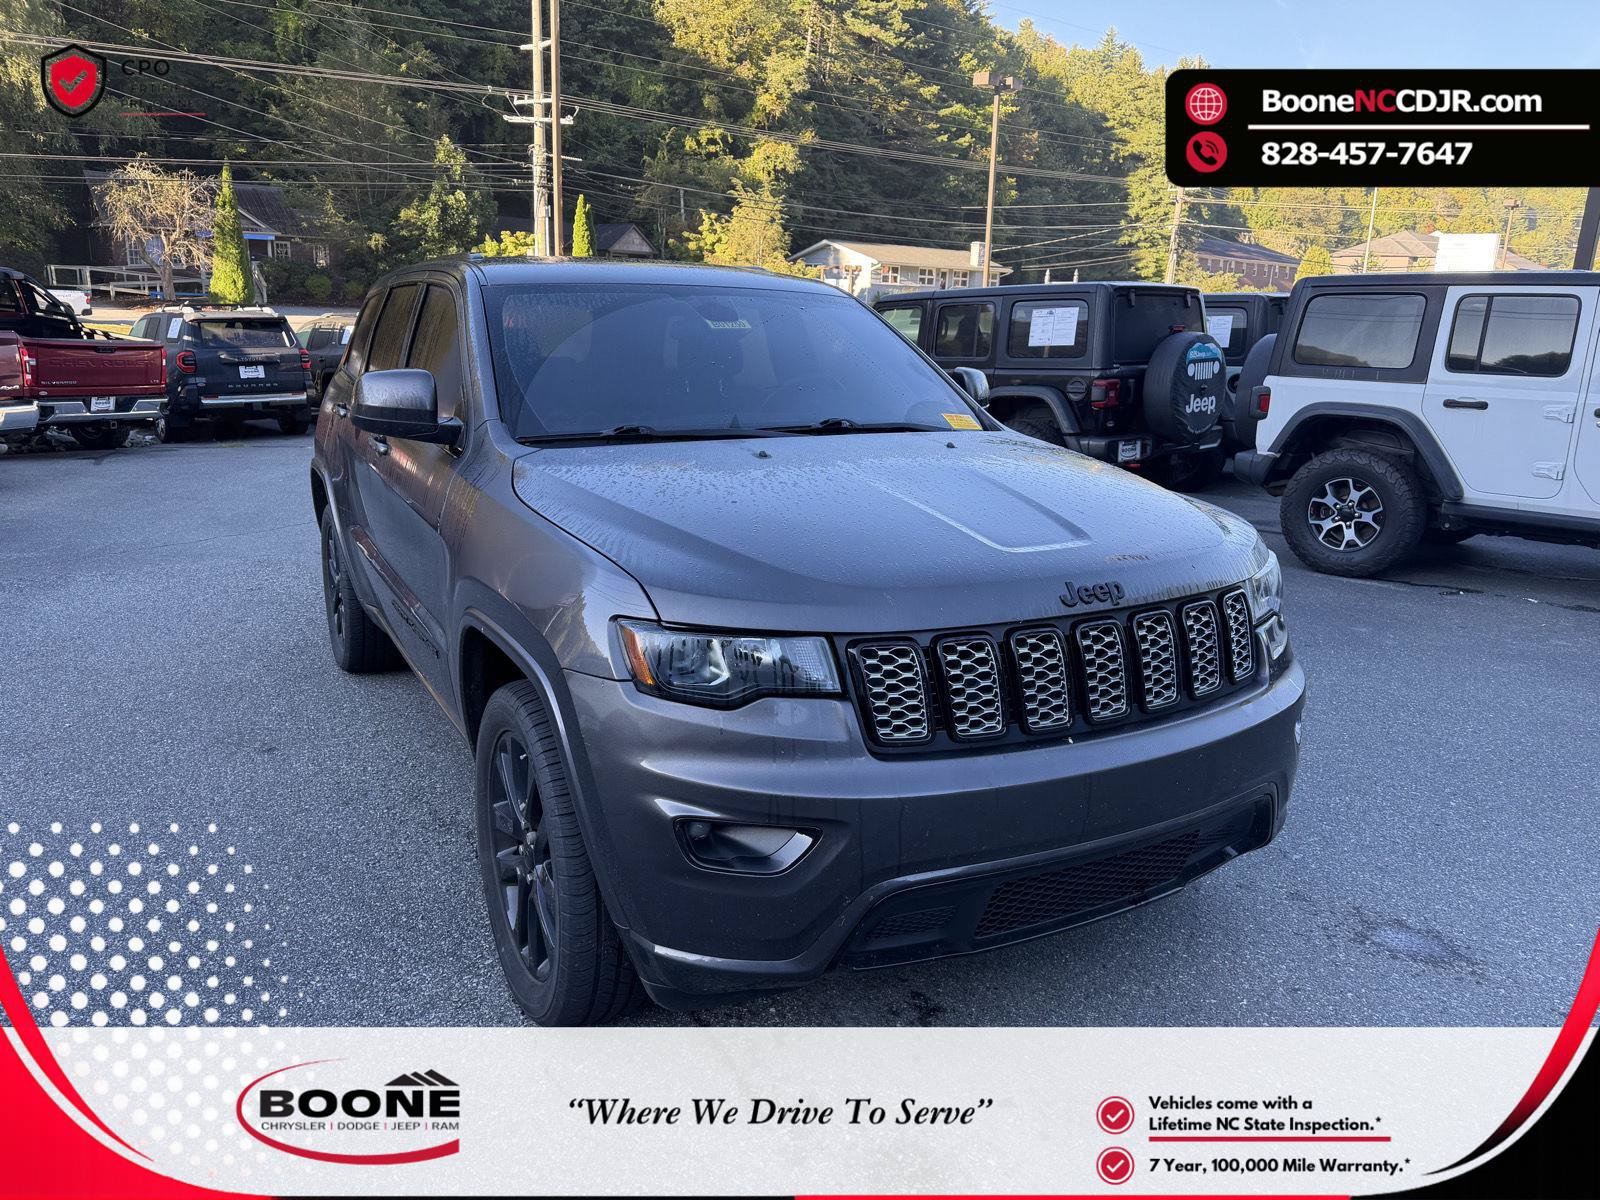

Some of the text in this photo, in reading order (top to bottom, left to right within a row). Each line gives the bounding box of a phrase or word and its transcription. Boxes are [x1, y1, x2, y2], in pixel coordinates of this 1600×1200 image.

[48, 358, 156, 368] CHEVROLET
[1185, 394, 1216, 414] Jeep
[1059, 581, 1126, 608] Jeep
